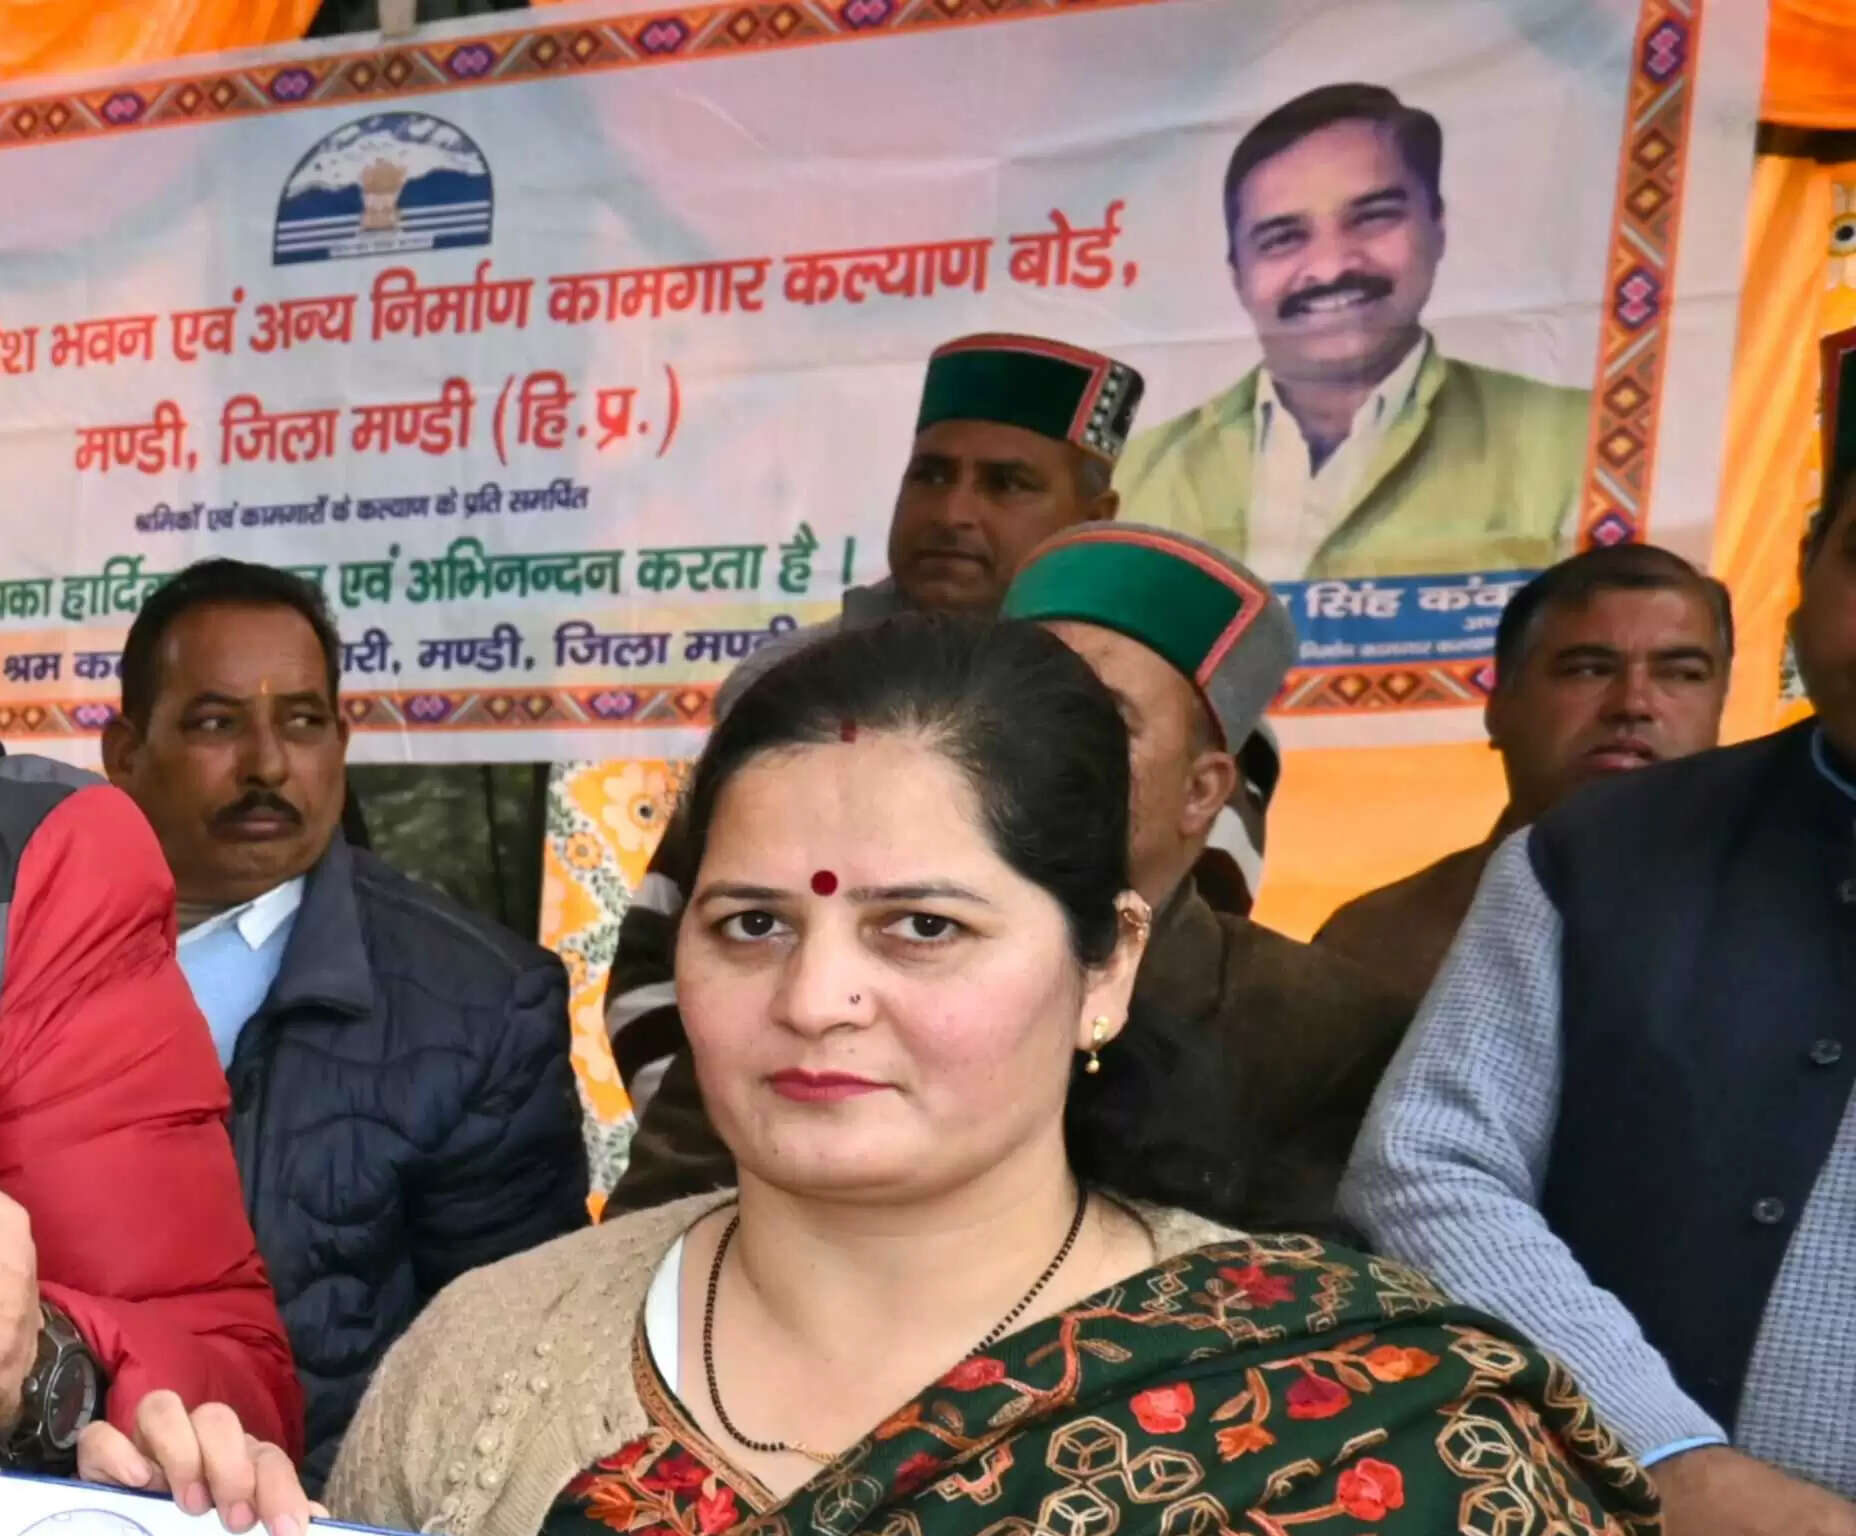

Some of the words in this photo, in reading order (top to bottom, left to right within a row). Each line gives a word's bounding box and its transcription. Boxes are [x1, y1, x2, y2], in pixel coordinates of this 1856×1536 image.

[49, 315, 157, 368] भवन
[170, 286, 246, 362] एवं
[248, 294, 358, 354] अन्य
[369, 258, 536, 342] निर्माण
[547, 257, 773, 325] कामगार
[782, 237, 995, 307] कल्याण
[1006, 200, 1137, 288] बोर्ड,
[75, 400, 197, 475] मण्डी,
[219, 394, 341, 466] जिला
[350, 375, 477, 456] मण्डी
[338, 543, 400, 609] एवं
[405, 536, 624, 603] अभिनन्दन
[637, 544, 768, 593] करता
[777, 522, 819, 594] है
[3, 652, 62, 682] श्रम
[418, 622, 535, 672] मण्डी,
[554, 620, 668, 667] जिला
